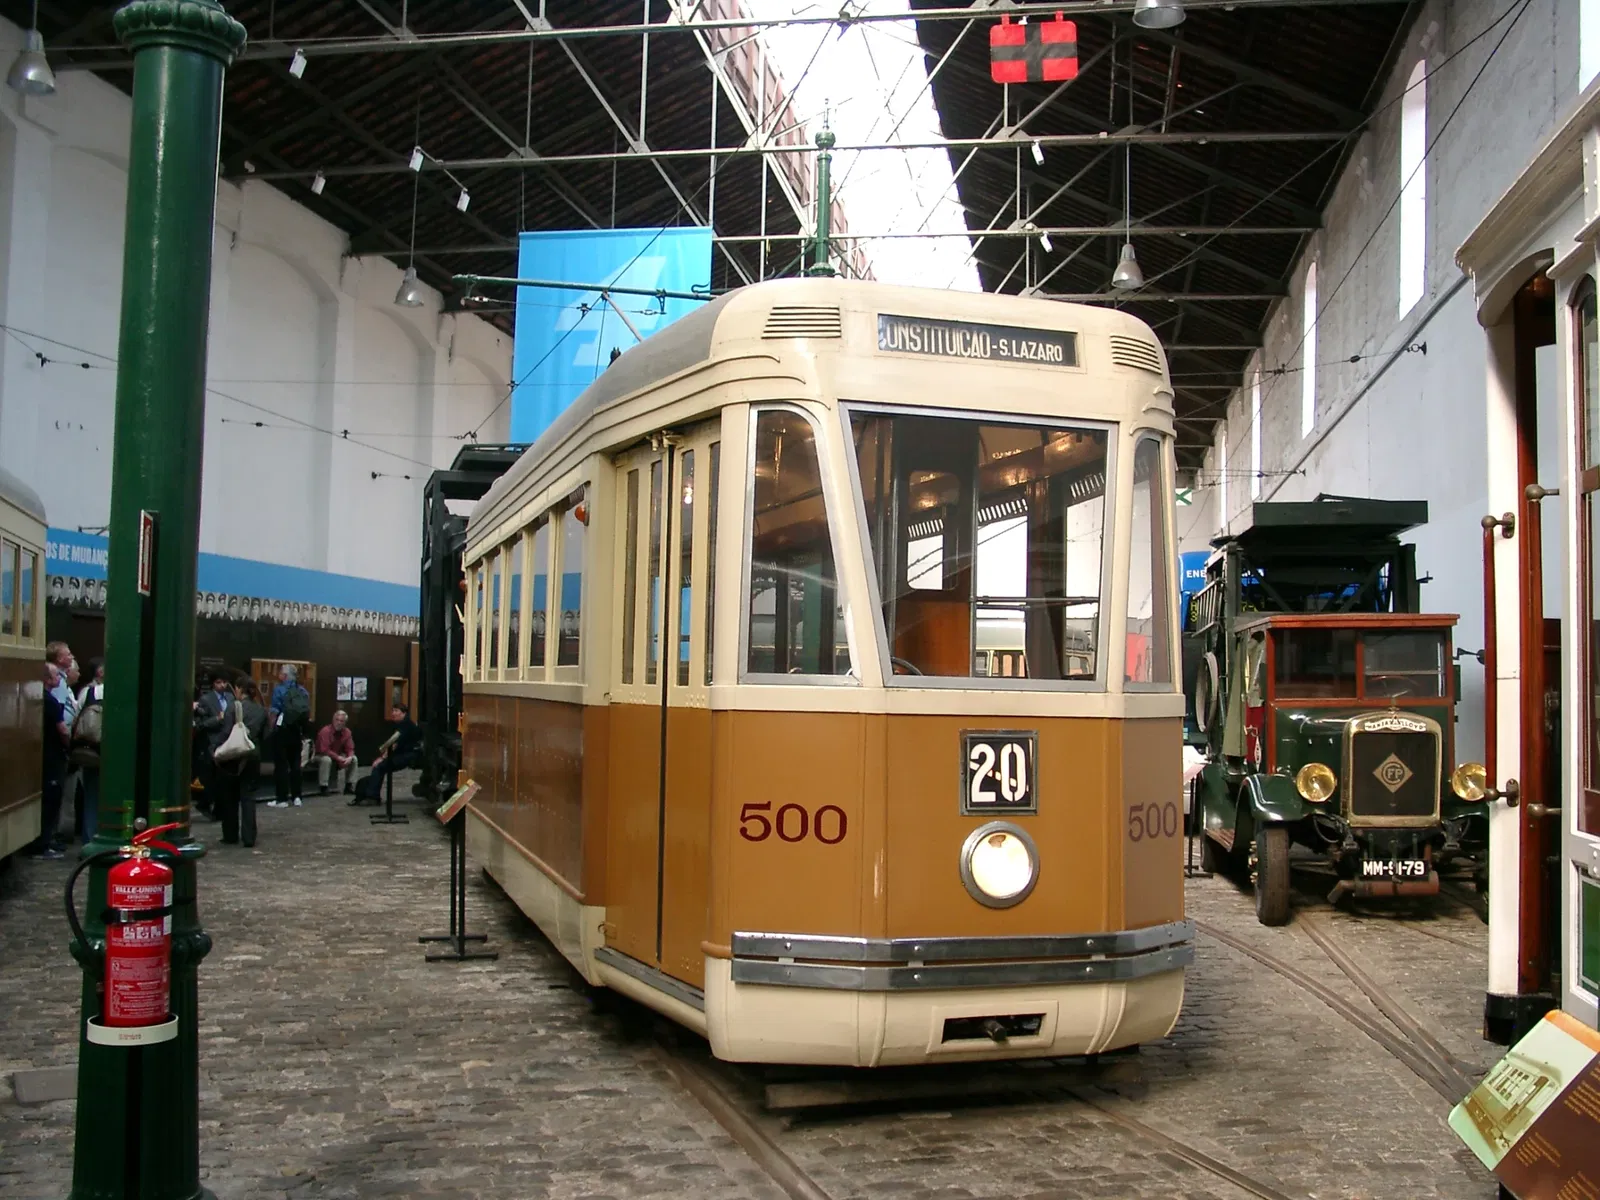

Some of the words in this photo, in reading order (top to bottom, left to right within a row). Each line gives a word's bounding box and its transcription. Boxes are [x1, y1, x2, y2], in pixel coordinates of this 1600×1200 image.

[59, 543, 71, 562] DE
[970, 743, 1027, 802] 20
[740, 801, 847, 844] 500
[1128, 801, 1178, 842] 500
